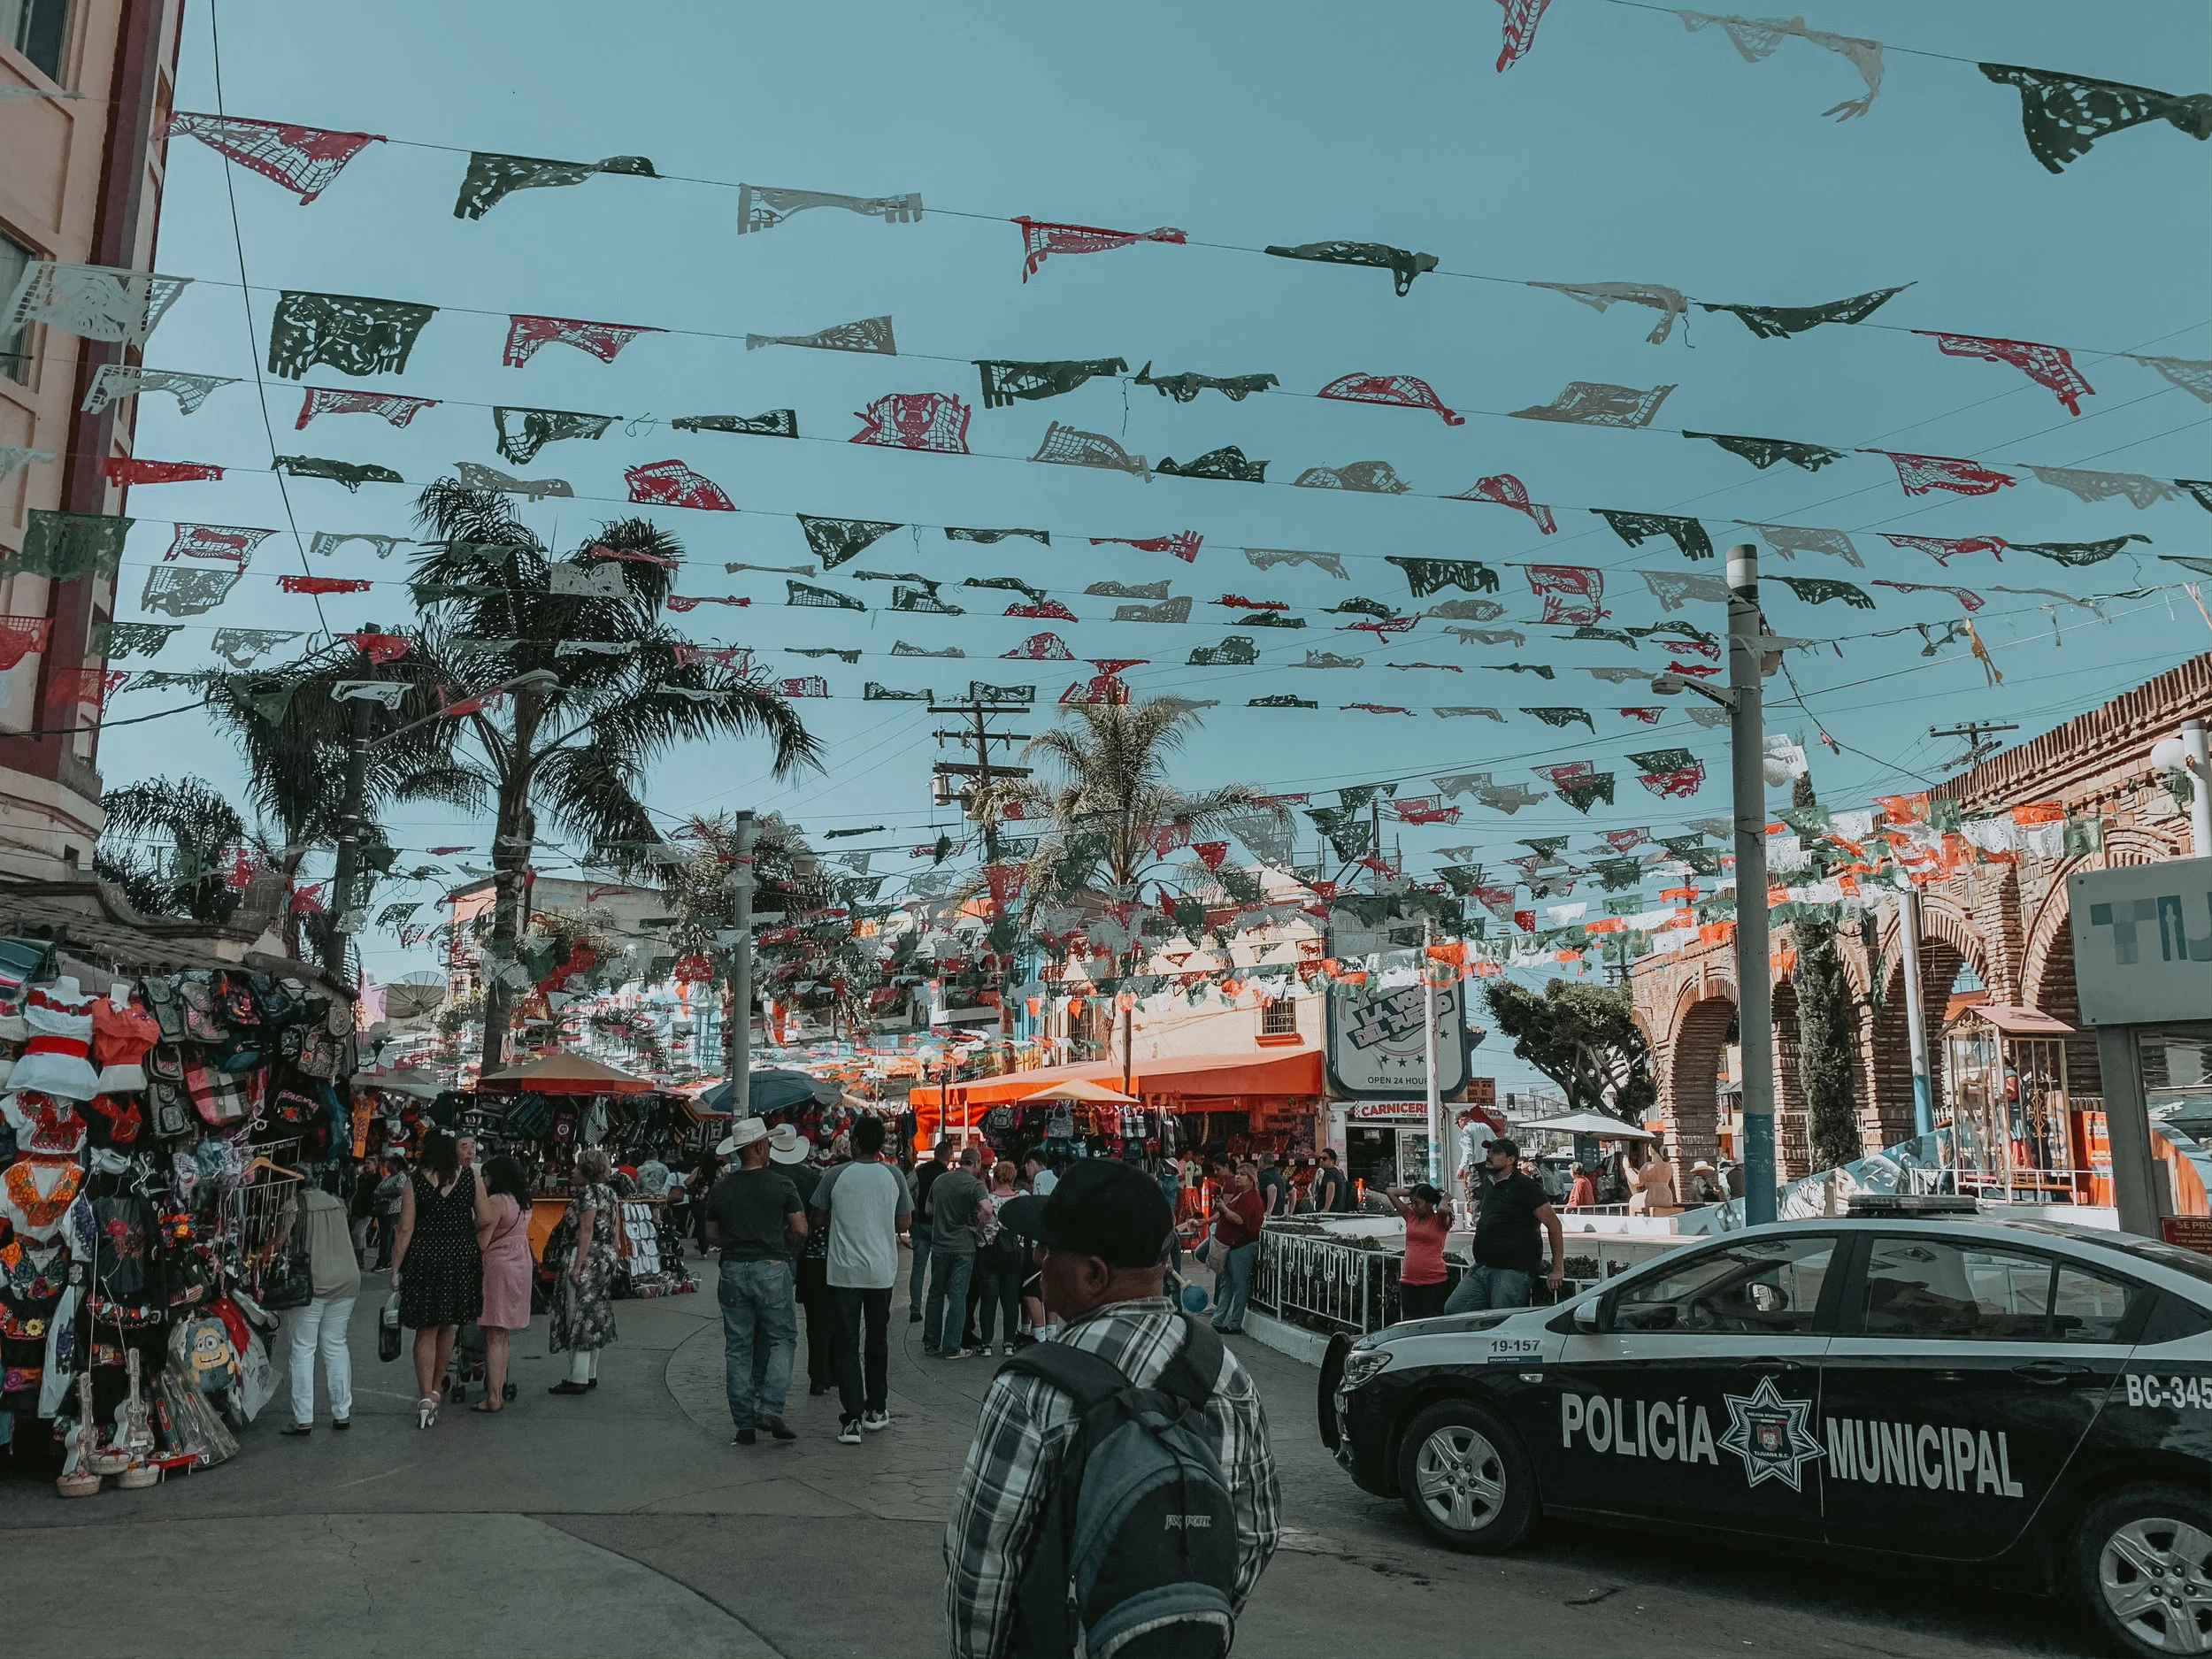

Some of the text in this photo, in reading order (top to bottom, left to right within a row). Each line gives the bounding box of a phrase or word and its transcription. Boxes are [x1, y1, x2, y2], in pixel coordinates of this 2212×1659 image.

[1360, 1002, 1391, 1025] LA
[1354, 1023, 1390, 1048] DEL
[1367, 1076, 1392, 1085] OPEN
[1405, 1077, 1428, 1086] HOU
[1361, 1102, 1428, 1117] CARNICERI
[1491, 1340, 1541, 1352] 19-157
[2125, 1374, 2212, 1409] BC-345
[1562, 1393, 2024, 1498] POLICÍA MUNICIPAL
[1164, 1515, 1211, 1530] JANPORT
